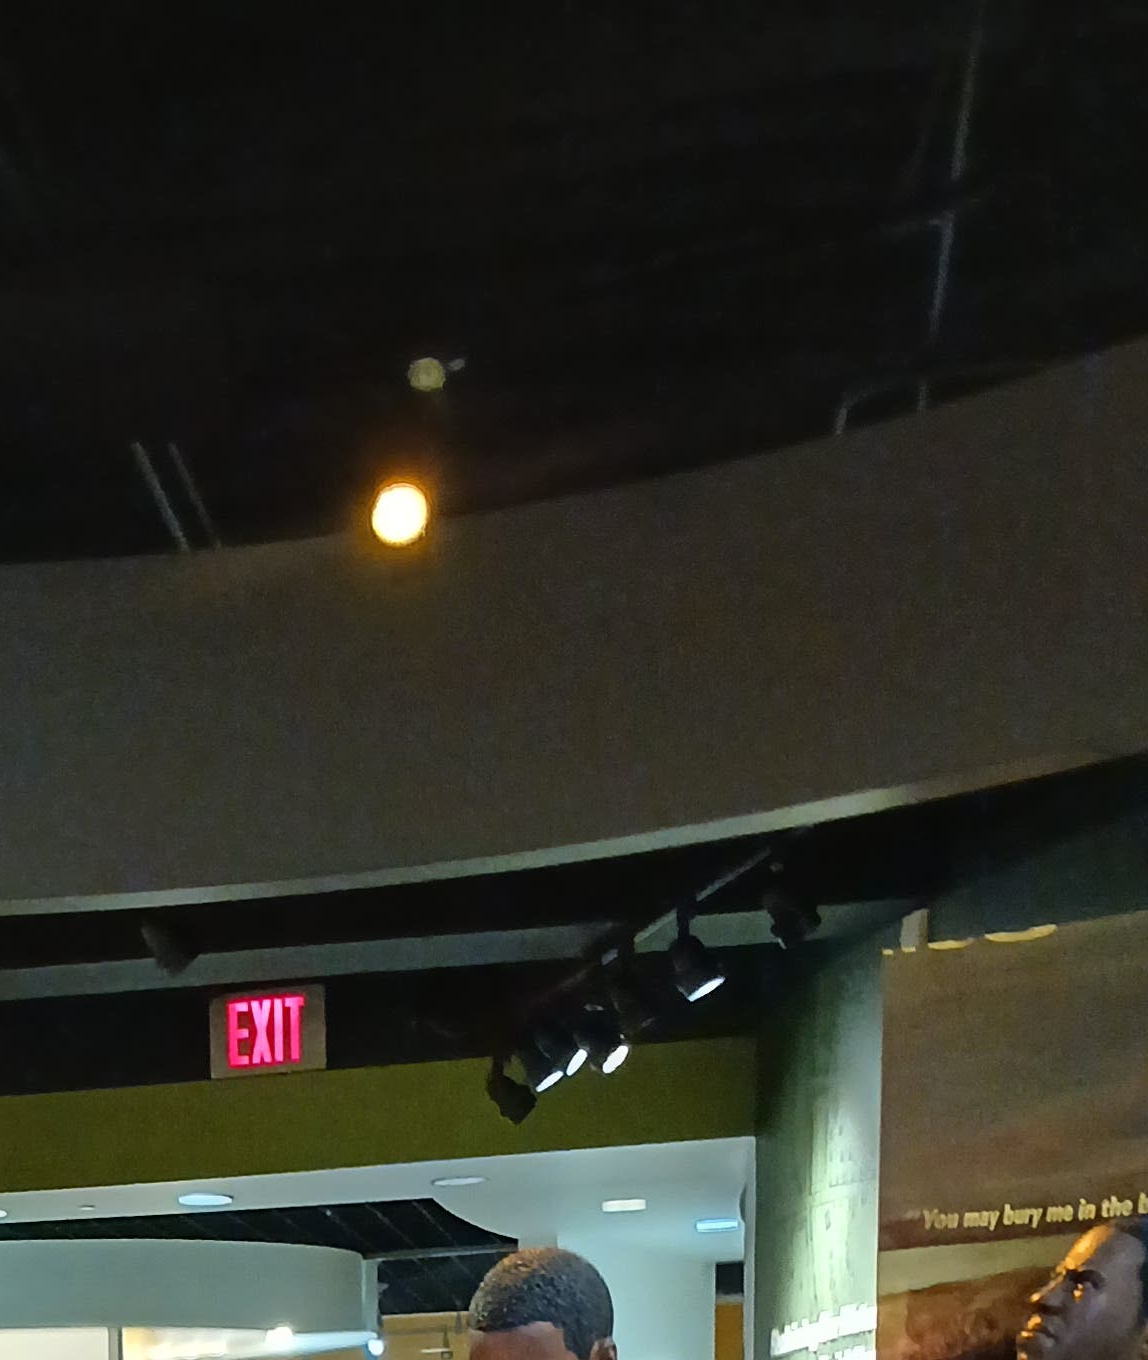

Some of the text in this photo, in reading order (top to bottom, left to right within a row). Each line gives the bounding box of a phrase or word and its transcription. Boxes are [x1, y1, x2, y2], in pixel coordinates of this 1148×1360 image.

[227, 995, 305, 1067] EXIT
[963, 1209, 1000, 1231] may
[1003, 1203, 1043, 1228] bury
[1046, 1204, 1074, 1222] me
[1078, 1198, 1096, 1221] in
[1102, 1195, 1133, 1218] the
